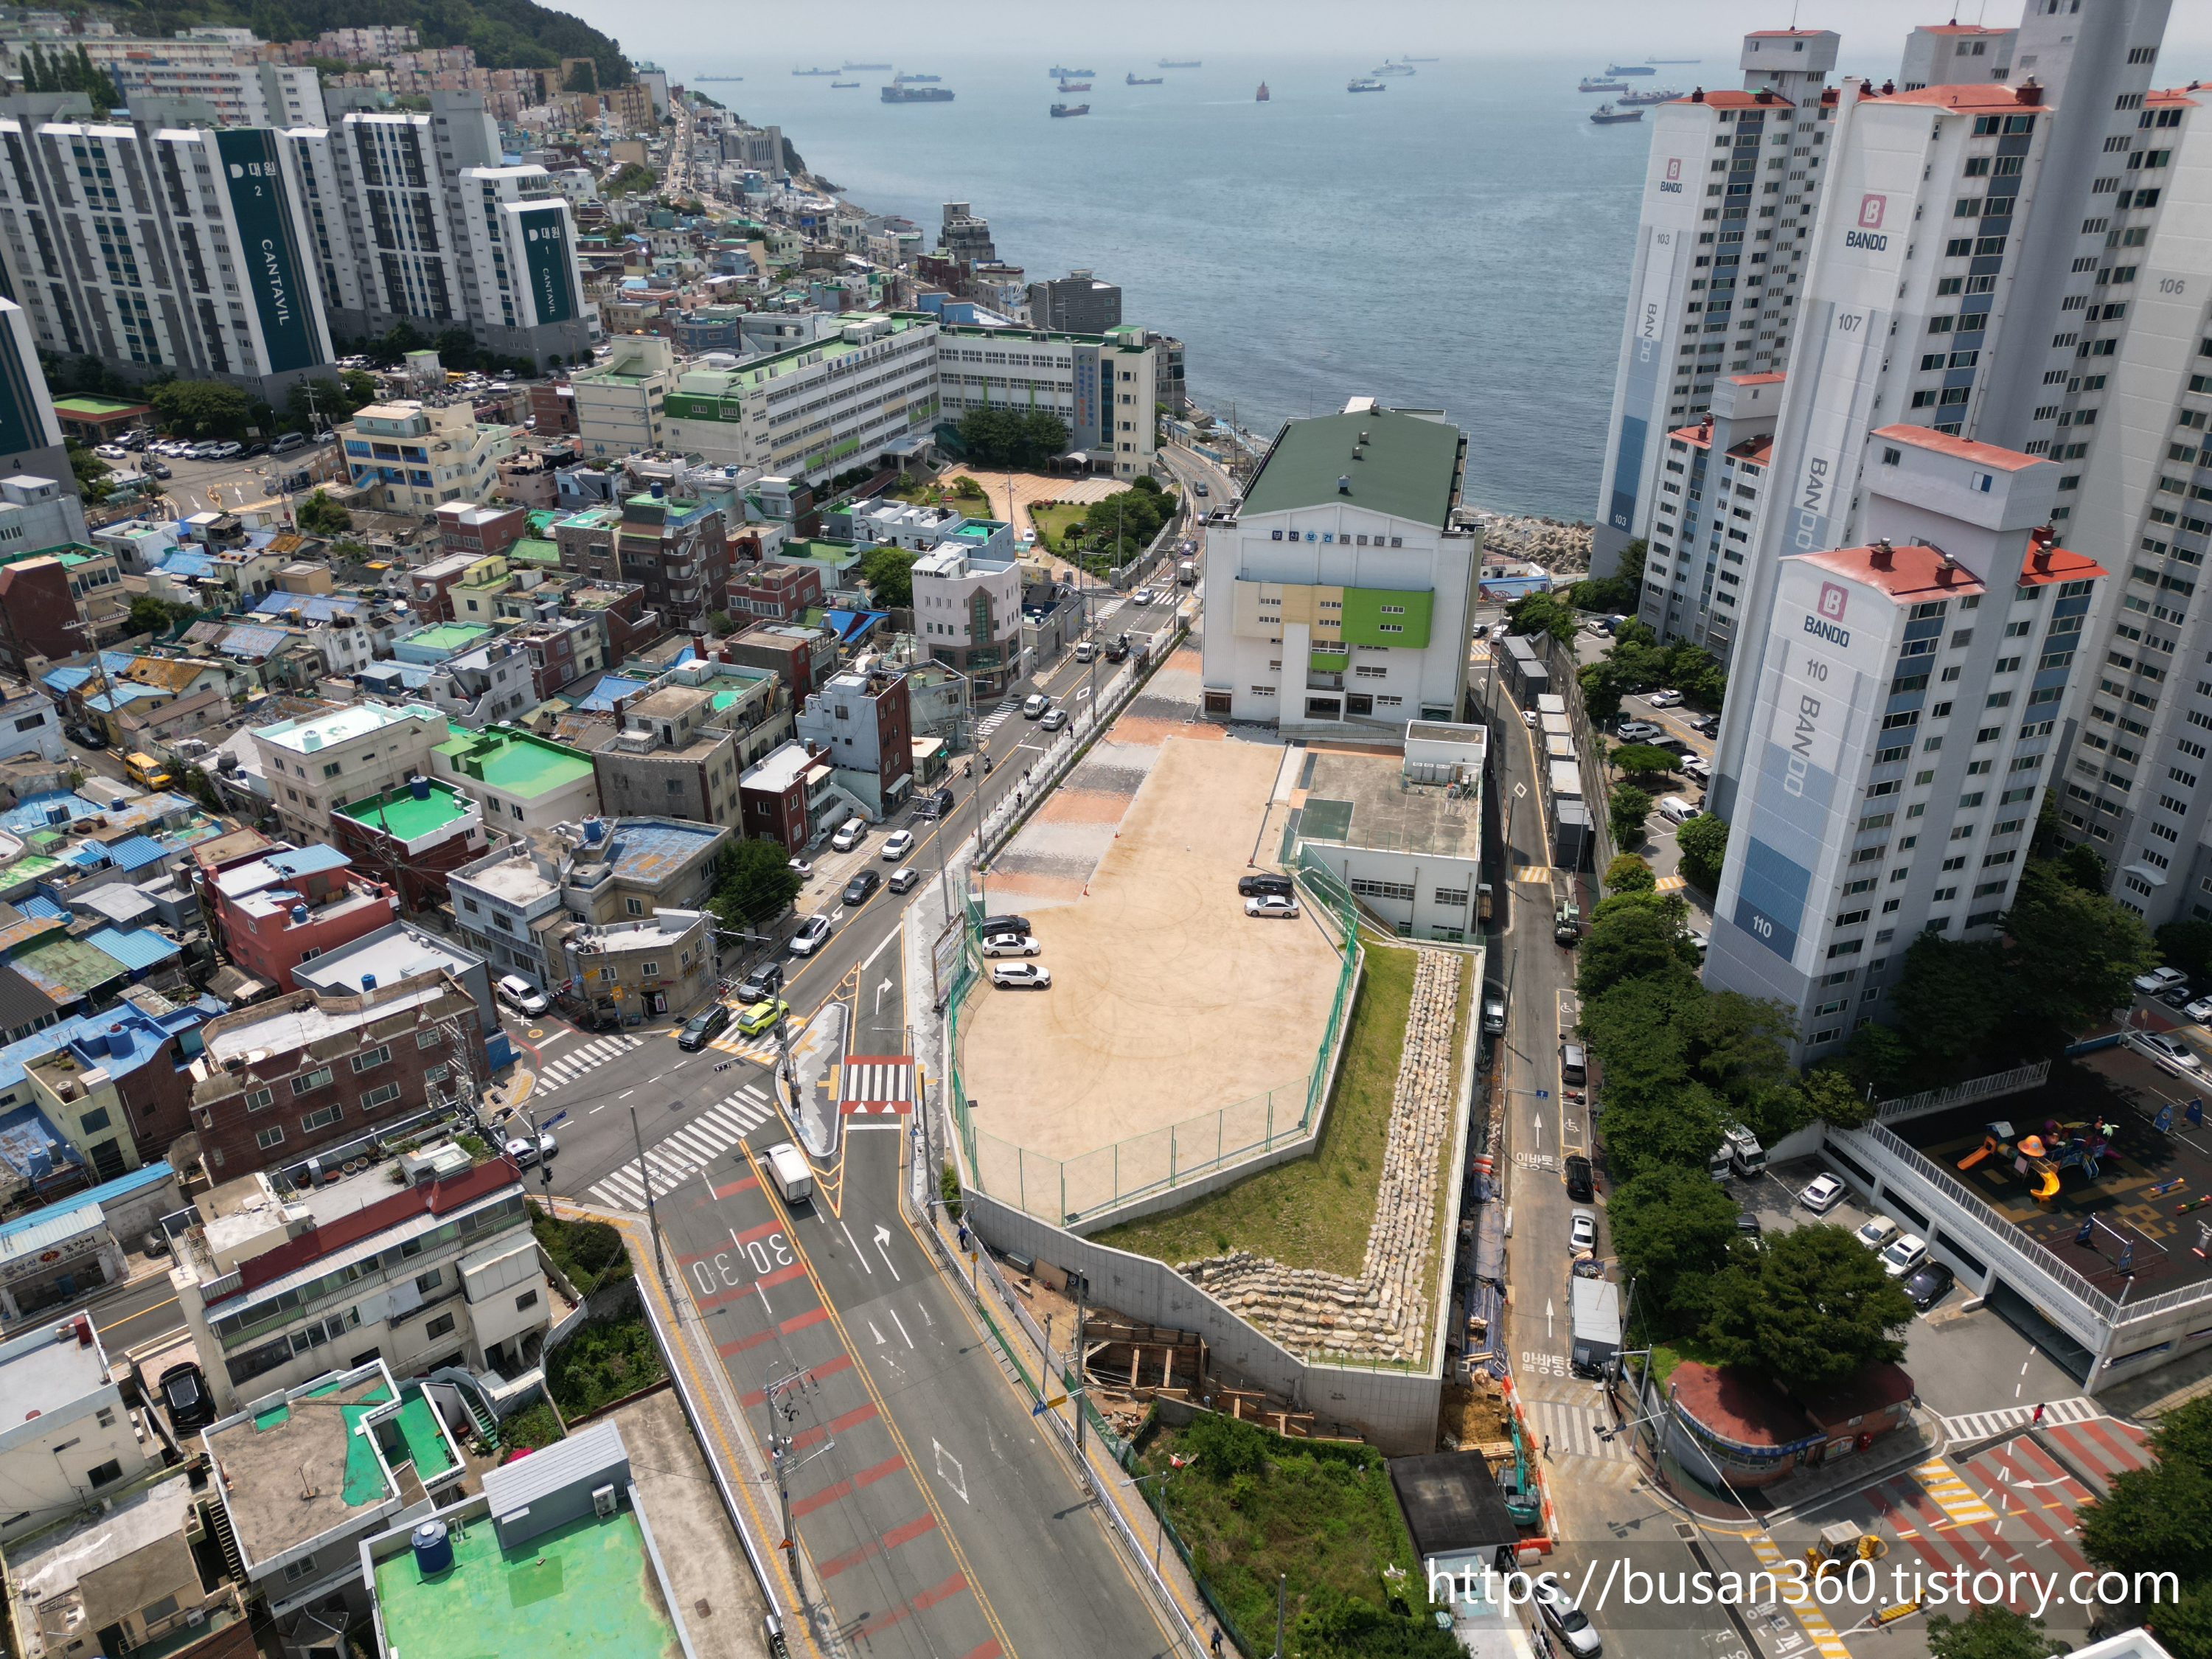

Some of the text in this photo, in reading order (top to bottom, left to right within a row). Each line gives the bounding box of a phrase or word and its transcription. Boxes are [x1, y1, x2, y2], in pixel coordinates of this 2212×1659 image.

[248, 161, 276, 177] 대원
[254, 186, 262, 196] 2
[1660, 181, 1683, 193] BANDO
[541, 226, 560, 239] 대원
[1657, 233, 1670, 245] 103
[1846, 231, 1888, 251] BANDO
[545, 246, 549, 254] 1
[262, 239, 290, 326] CANTAVIL
[543, 268, 556, 316] CANTAVIL
[2159, 278, 2185, 295] 106
[1640, 303, 1657, 363] BANDO
[1839, 313, 1862, 333] 107
[299, 373, 305, 383] 2
[13, 459, 21, 470] 4
[1795, 457, 1829, 549] BANDO
[1615, 513, 1627, 526] 103
[1273, 531, 1402, 547] 부산보건고등학교
[1804, 615, 1850, 648] BANDO
[1806, 658, 1828, 682] 110
[1784, 695, 1820, 798] BANDO
[1753, 915, 1773, 938] 110
[747, 1234, 793, 1274] 30
[692, 1253, 739, 1295] 30
